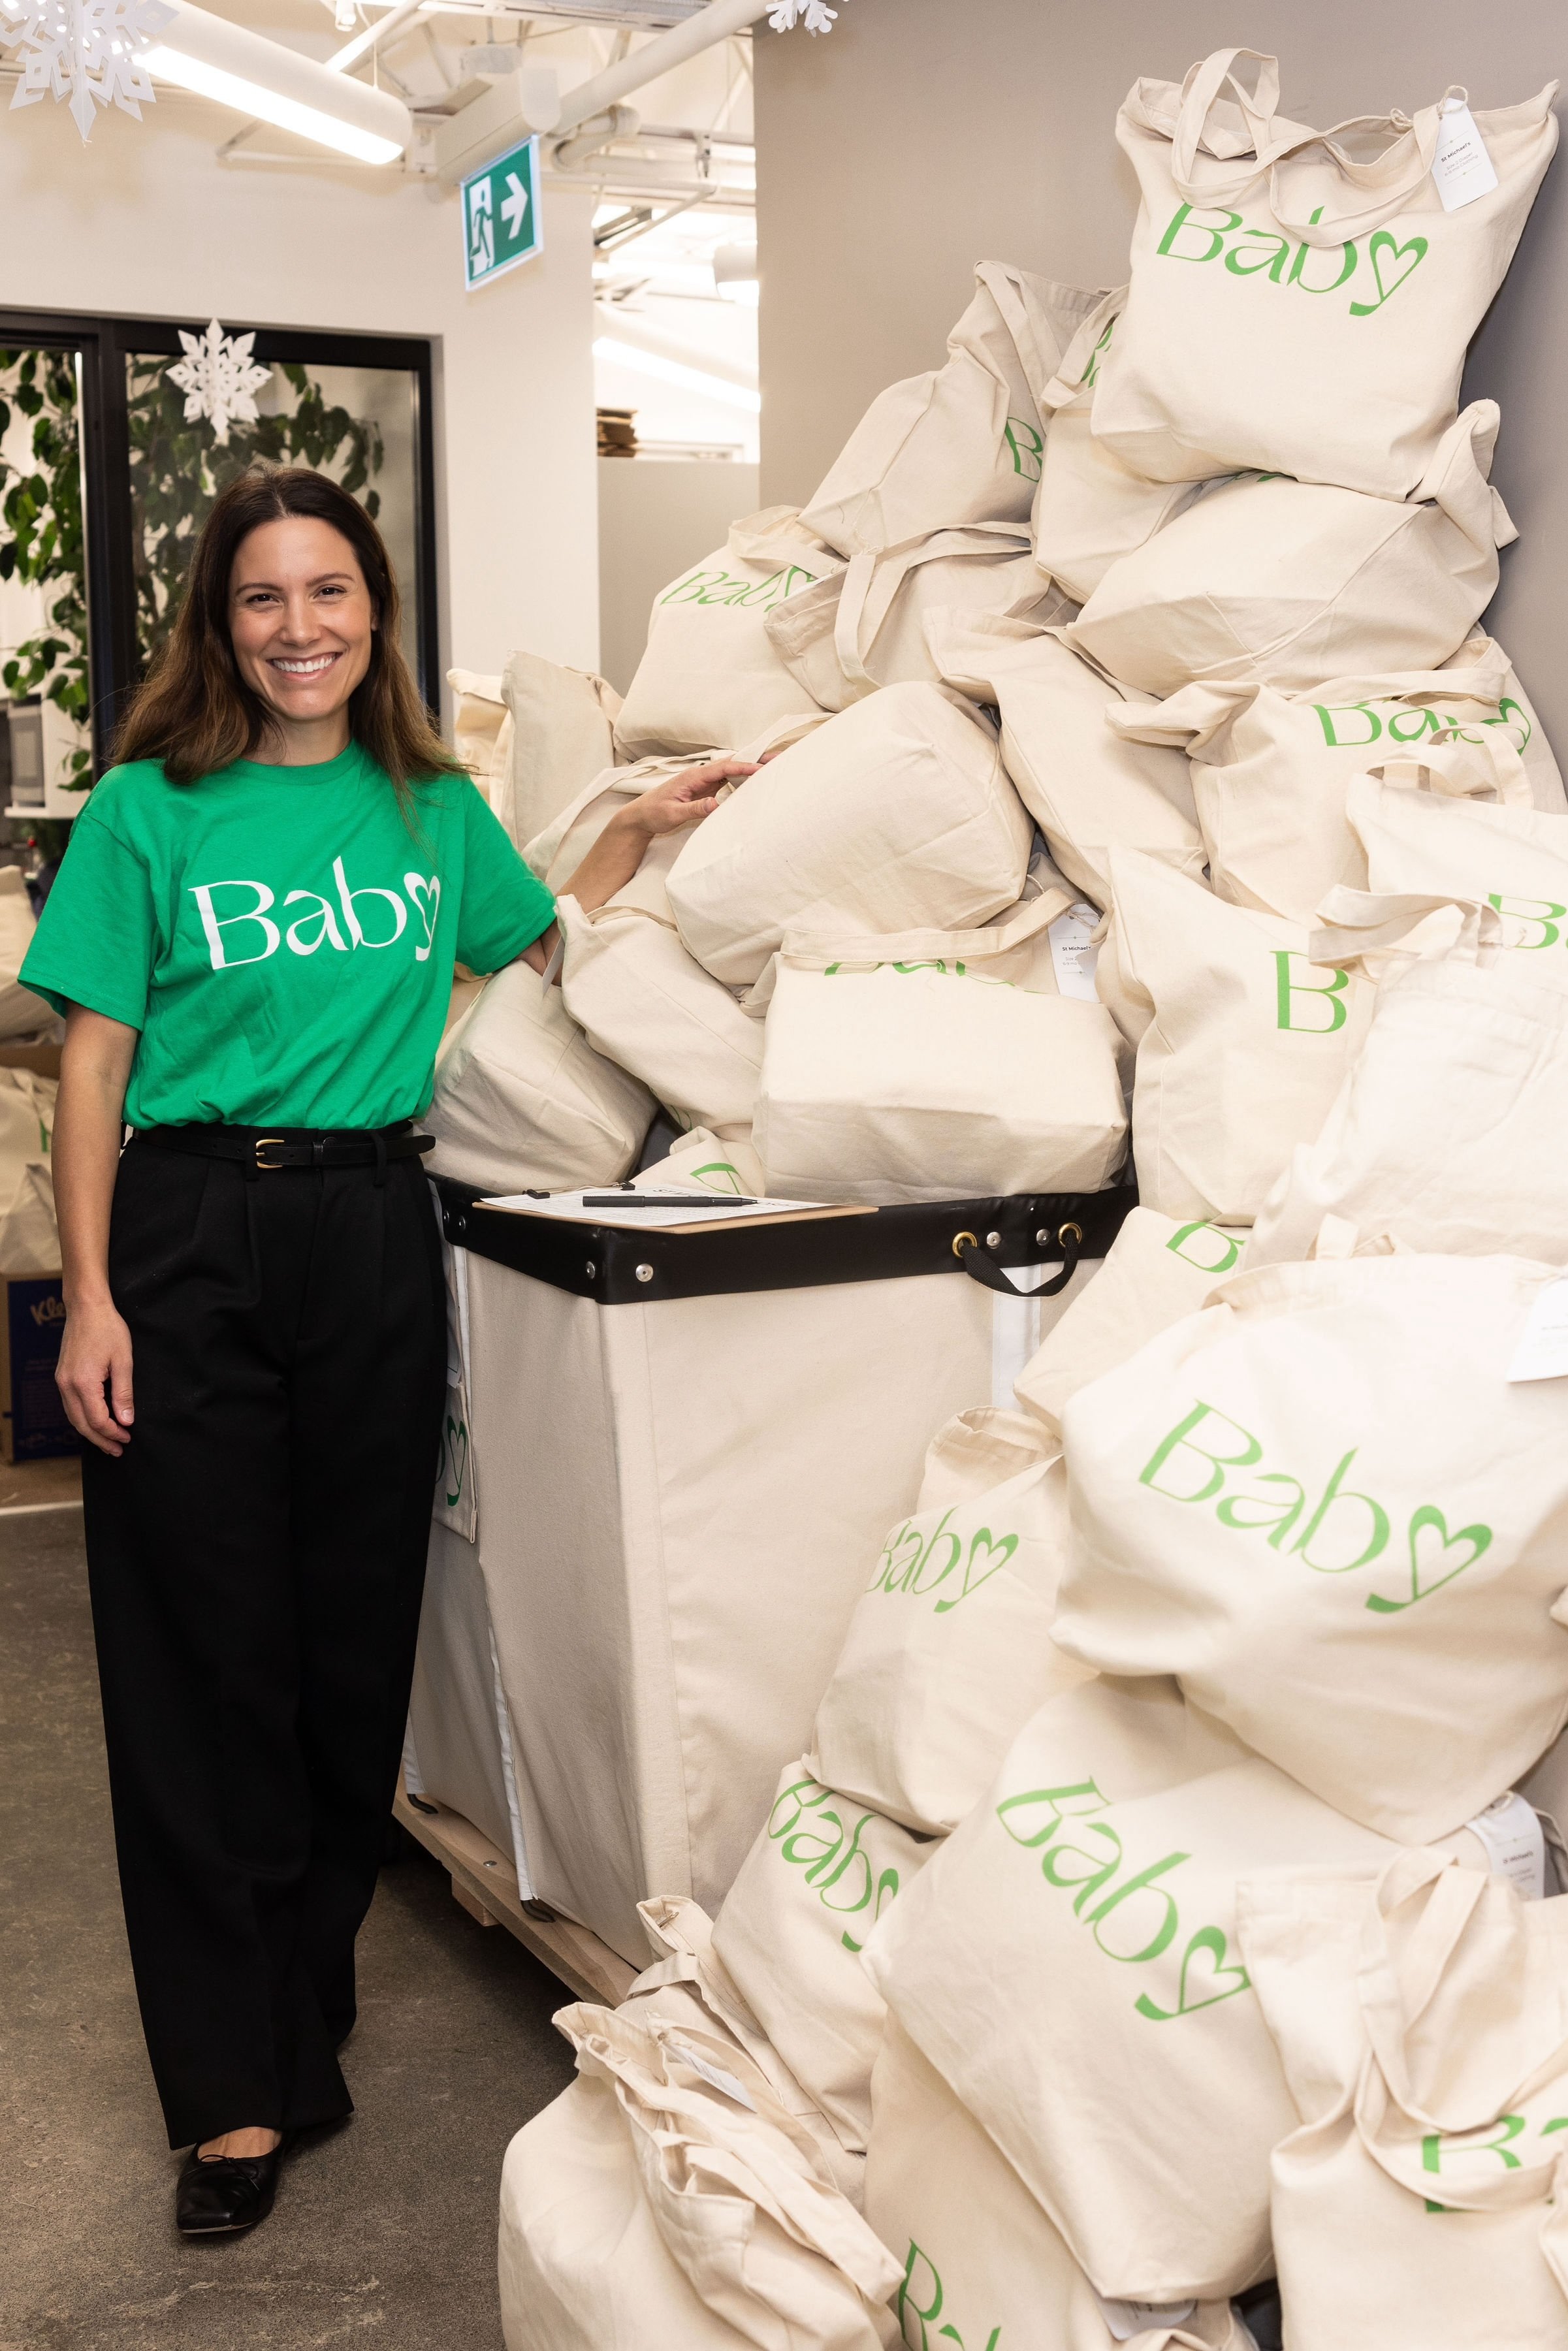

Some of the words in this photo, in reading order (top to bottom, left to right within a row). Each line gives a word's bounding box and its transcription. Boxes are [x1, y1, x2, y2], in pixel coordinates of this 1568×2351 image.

[1448, 142, 1471, 158] Michael's
[1156, 202, 1428, 317] Baby
[187, 856, 441, 970] Baby
[1138, 1398, 1493, 1614] Baby
[996, 1775, 1252, 2021] Baby
